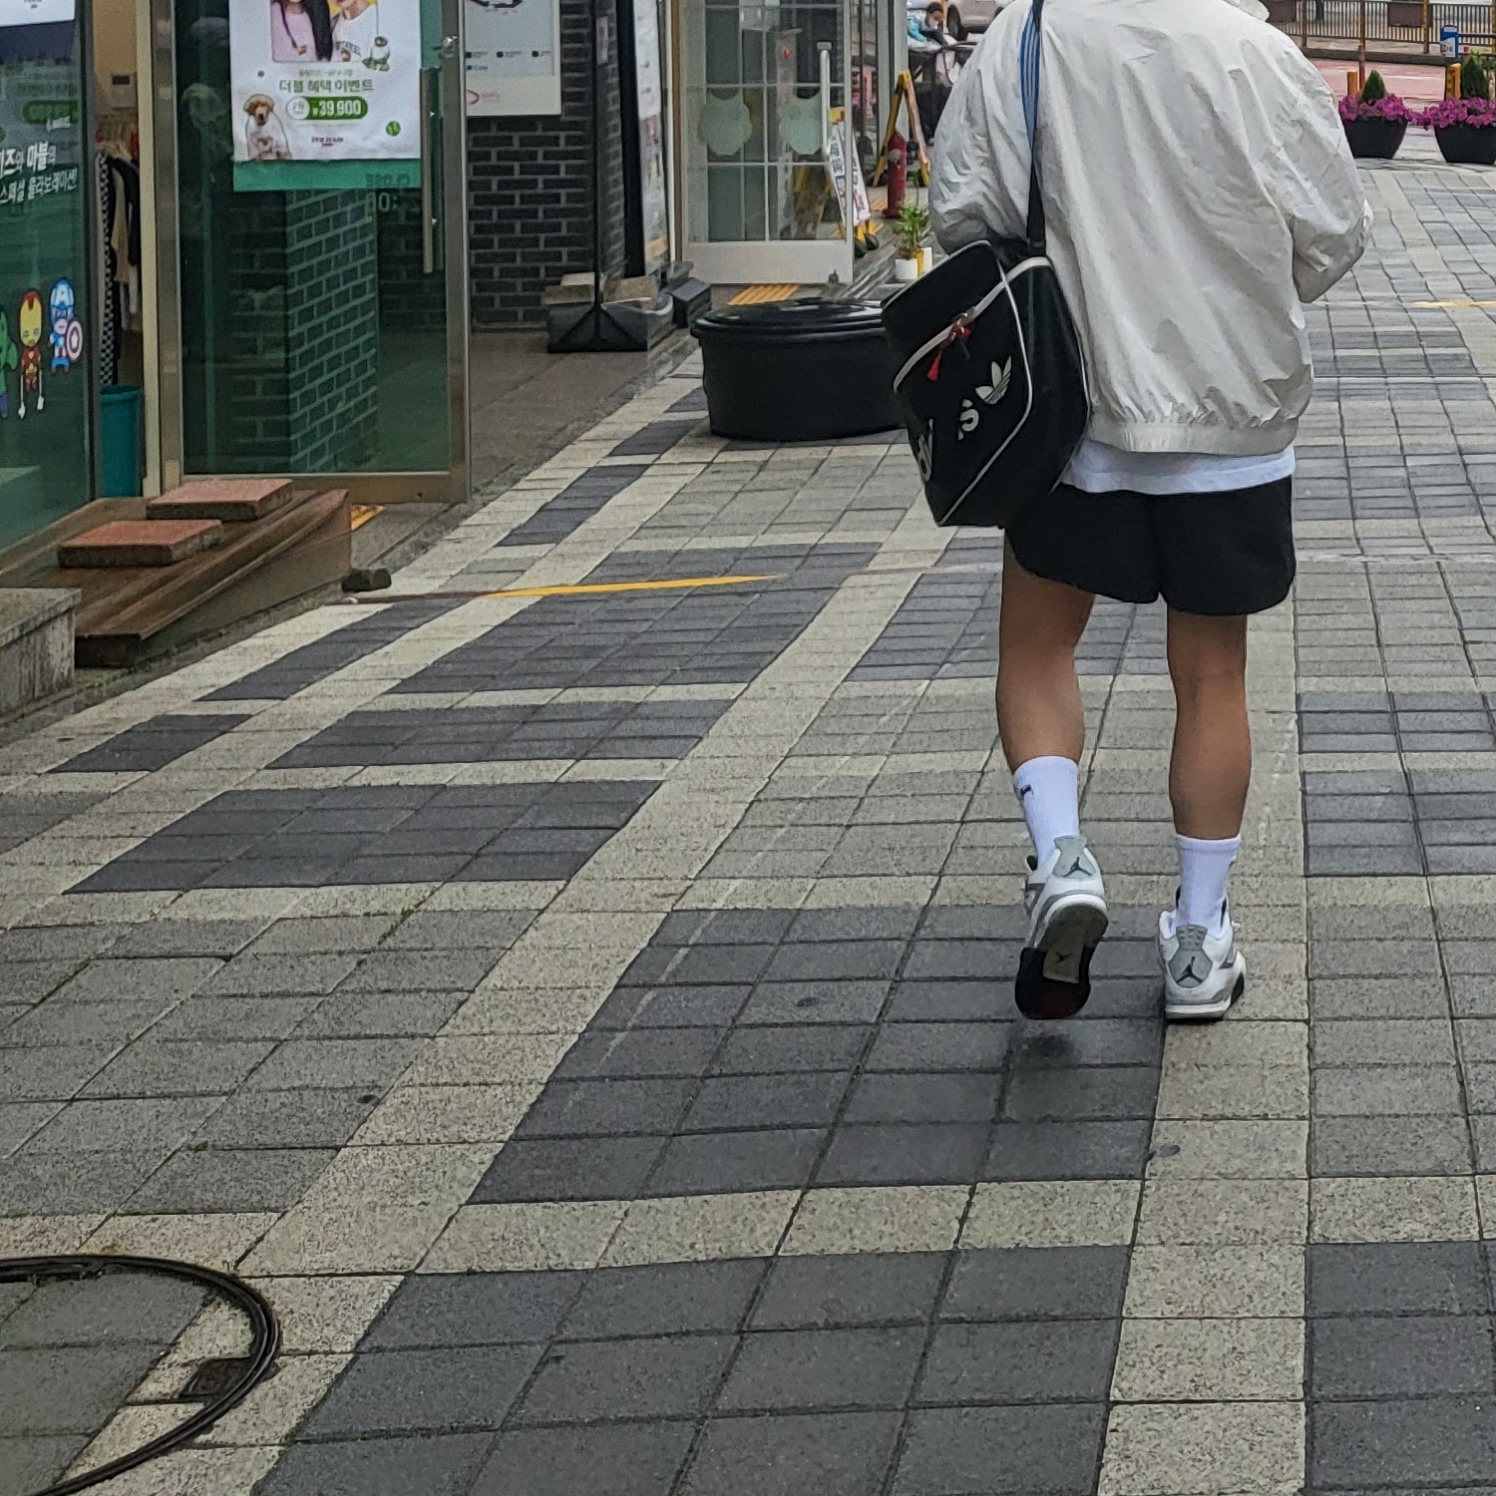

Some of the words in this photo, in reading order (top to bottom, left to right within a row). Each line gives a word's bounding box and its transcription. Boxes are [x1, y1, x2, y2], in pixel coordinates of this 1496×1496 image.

[279, 79, 305, 94] 더블
[308, 79, 332, 94] 혜택
[334, 78, 376, 94] 이벤트
